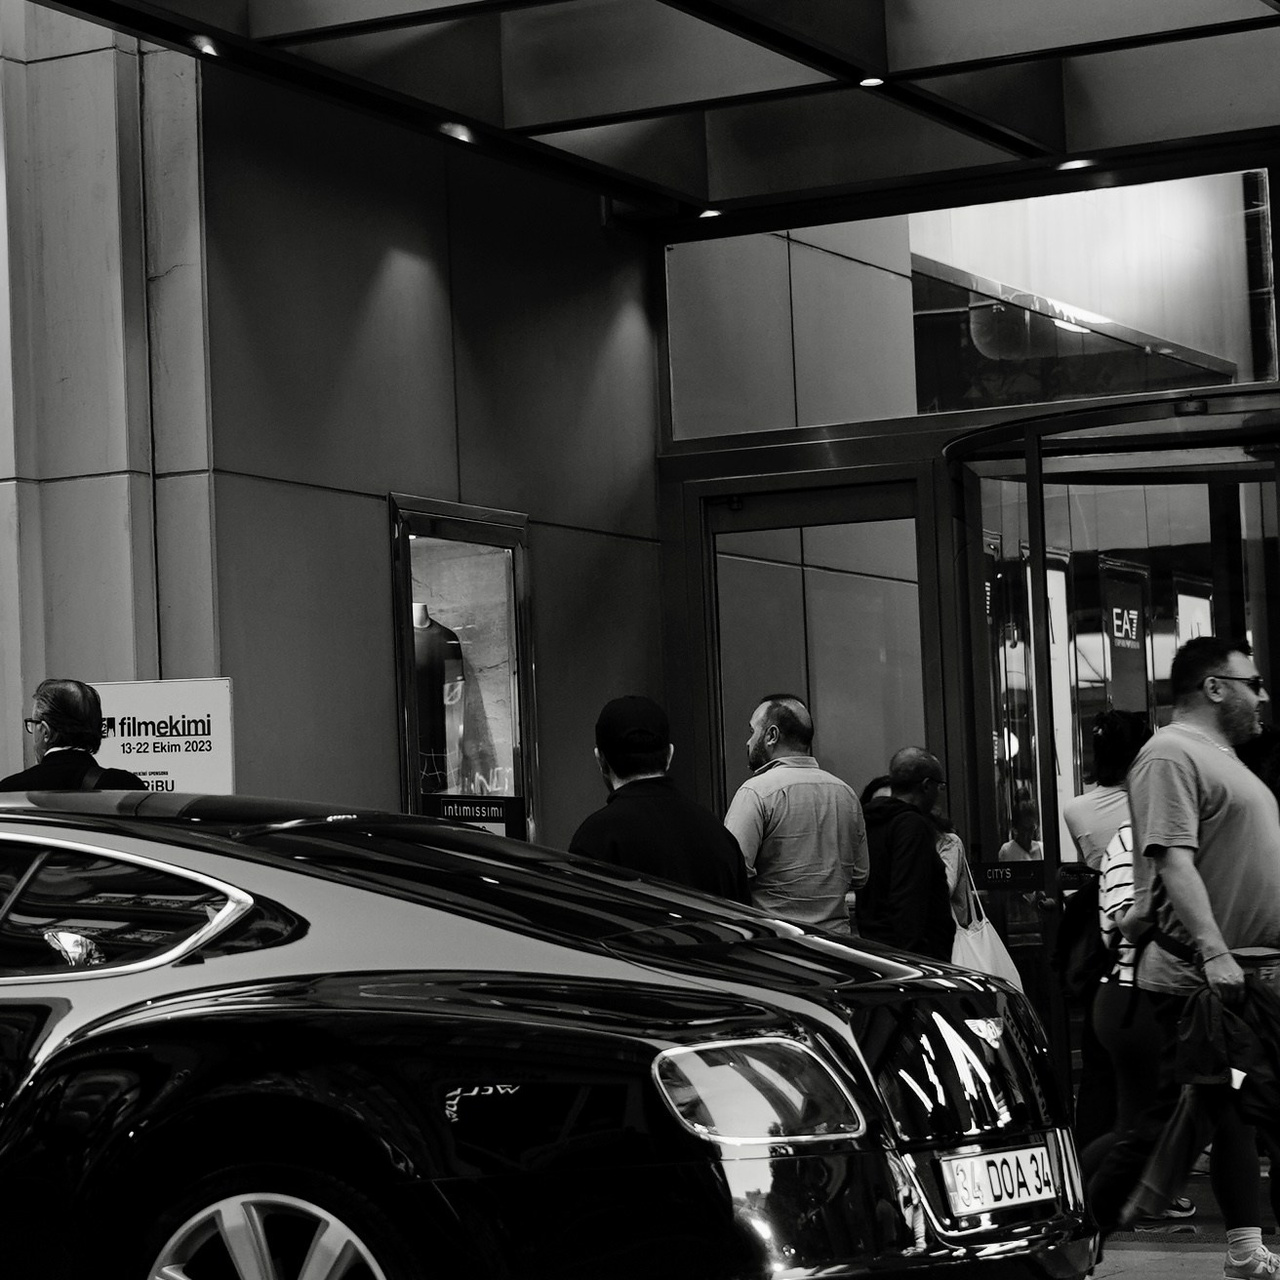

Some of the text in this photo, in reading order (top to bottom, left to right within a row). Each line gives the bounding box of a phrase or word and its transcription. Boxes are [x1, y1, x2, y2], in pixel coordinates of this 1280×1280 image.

[119, 713, 211, 738] filmekimi
[121, 740, 213, 754] 13-22 Ekim 2023
[956, 1152, 1052, 1208] 34 DOA 34
